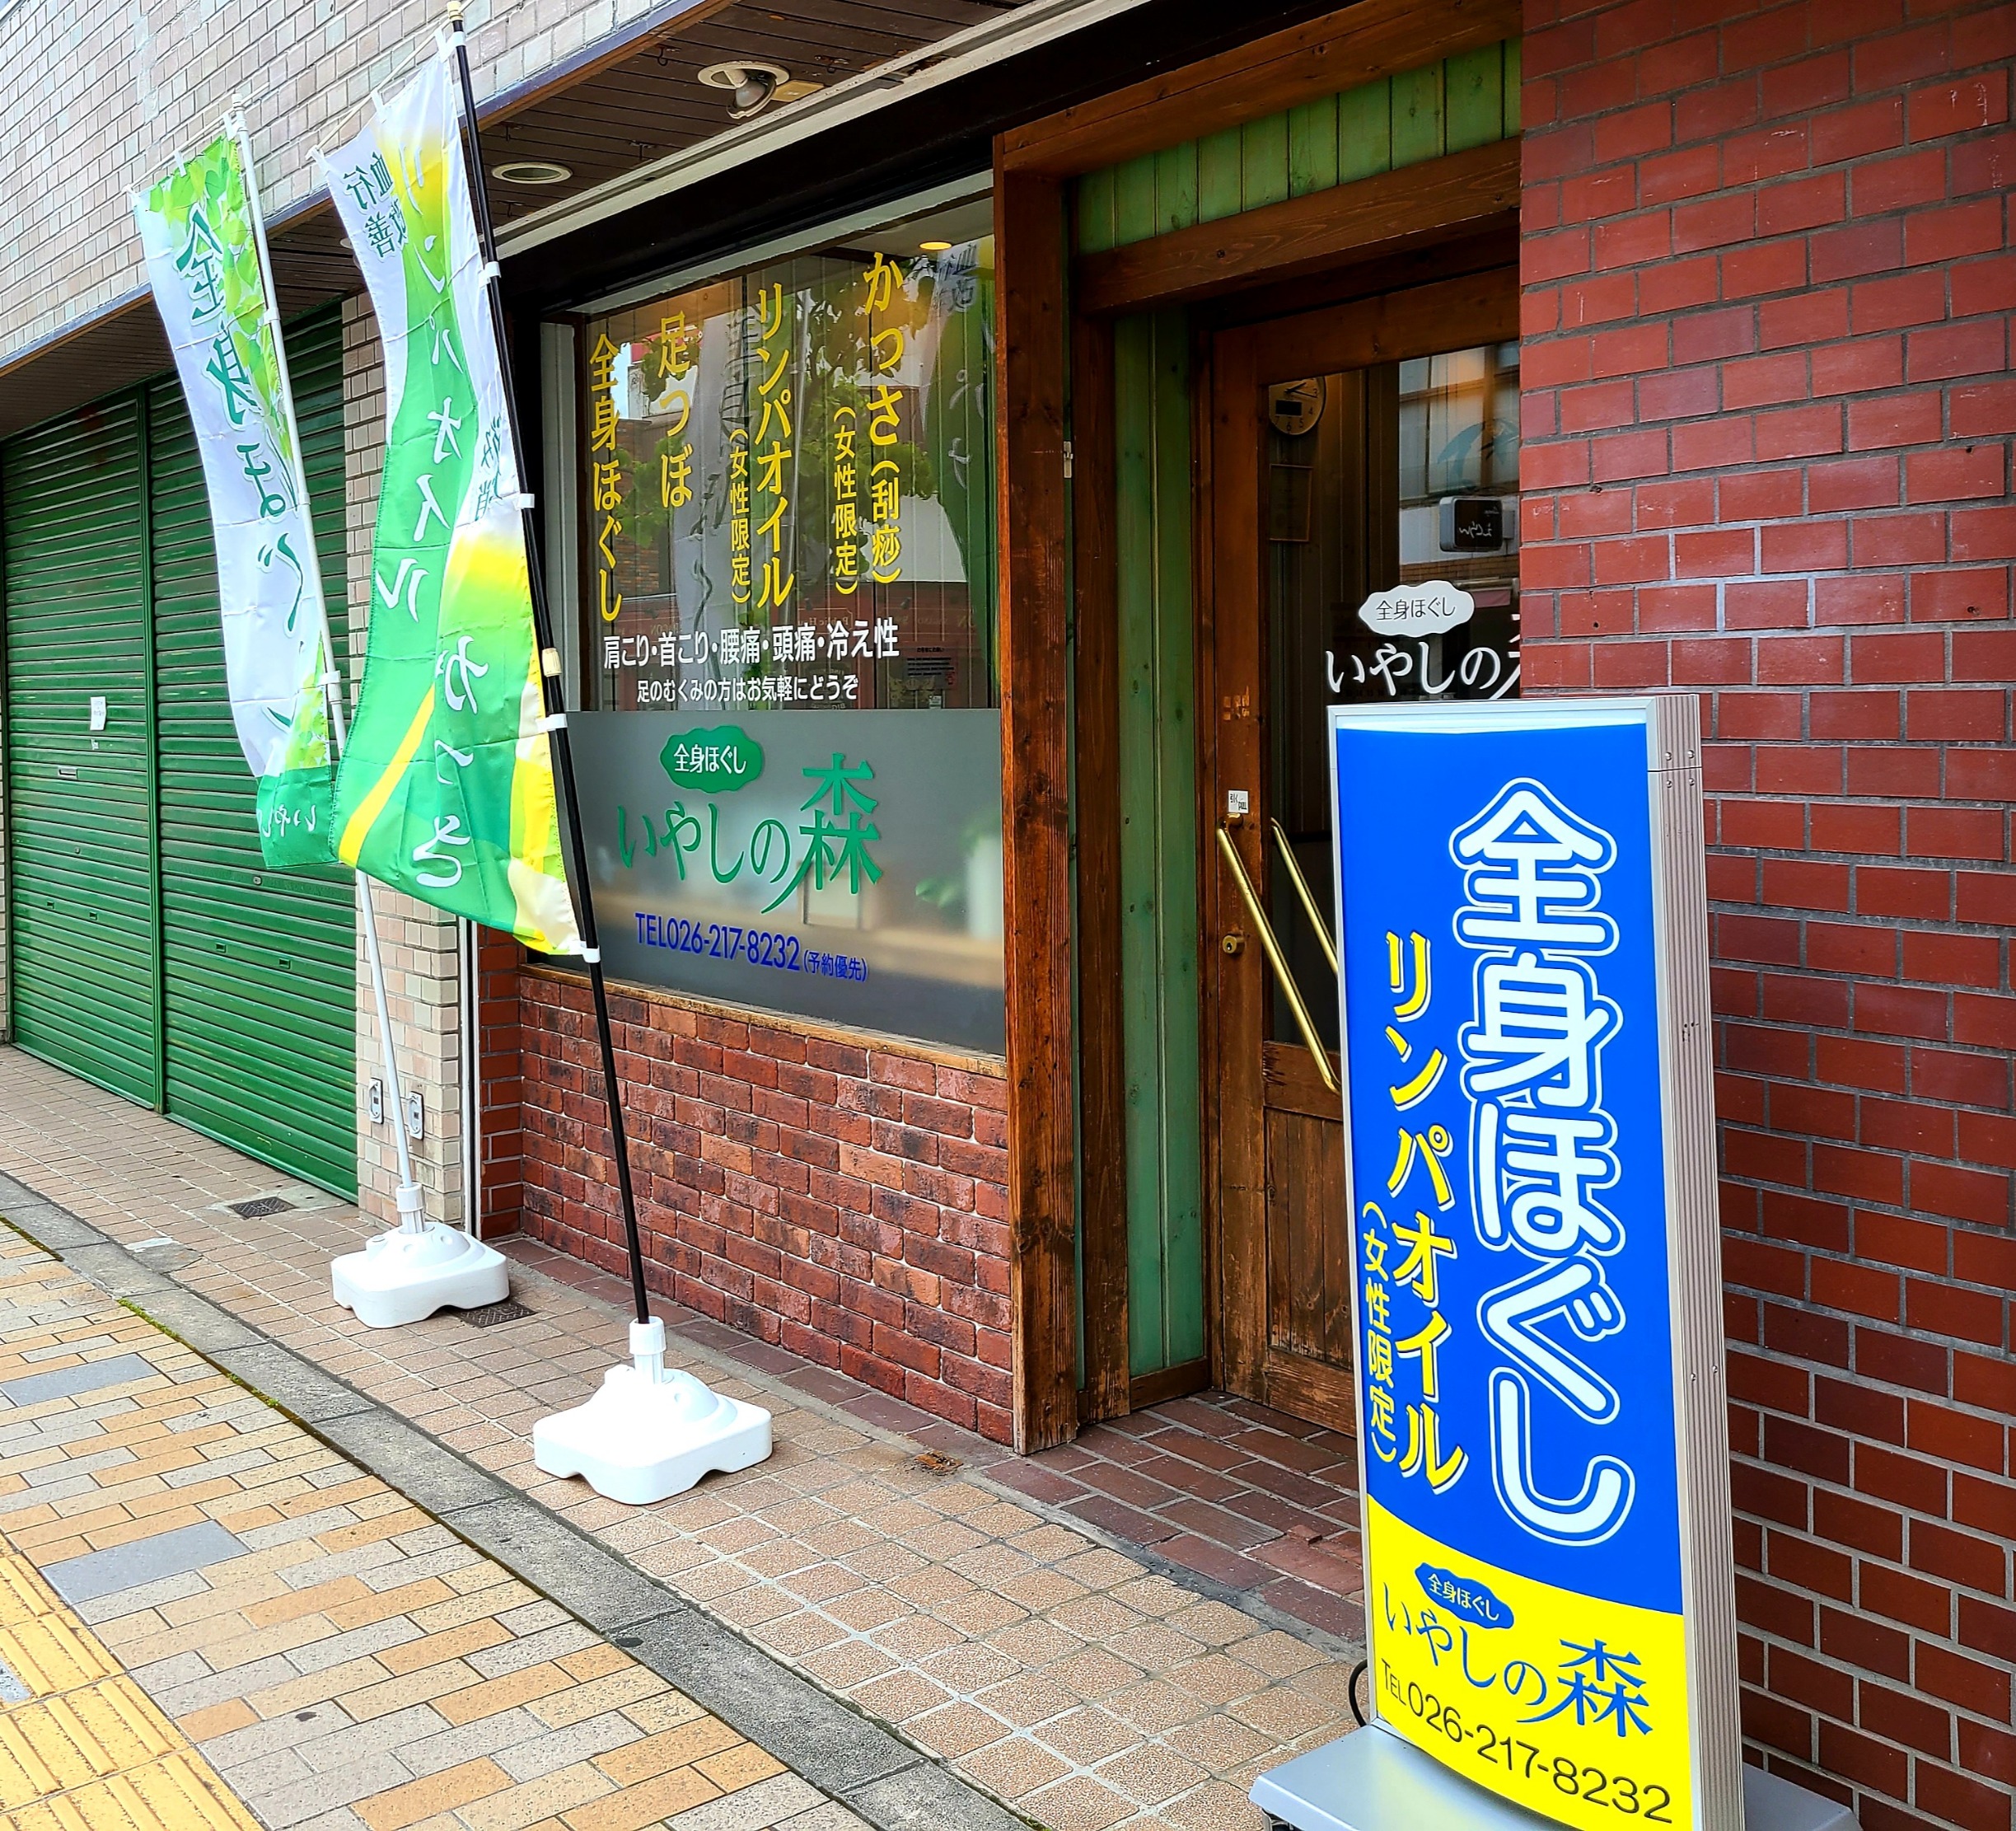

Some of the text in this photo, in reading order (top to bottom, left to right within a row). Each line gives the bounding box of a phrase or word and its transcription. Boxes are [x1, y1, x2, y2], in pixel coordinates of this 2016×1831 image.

[589, 333, 624, 622] 全身ほぐし
[658, 310, 695, 508] 足つぼ
[754, 283, 794, 609] リンパオイル
[729, 428, 751, 605] （女性限定）
[832, 405, 858, 595] （女性限定）
[603, 616, 900, 670] 肩こり・首こり・腰痛・頭痛・冷え性
[636, 673, 859, 704] 足のむくみの方はお気軽にどうぞ
[1375, 597, 1457, 621] 全身ほぐし
[617, 752, 882, 915] いやしの森
[673, 743, 747, 774] 全身ほぐし
[1386, 930, 1470, 1495] リンパオイル
[1448, 777, 1635, 1547] 全身ほぐし
[1363, 1200, 1397, 1466] （女性限定）
[1383, 1581, 1653, 1739] いやしの森
[1426, 1572, 1501, 1623] 全身ほぐし
